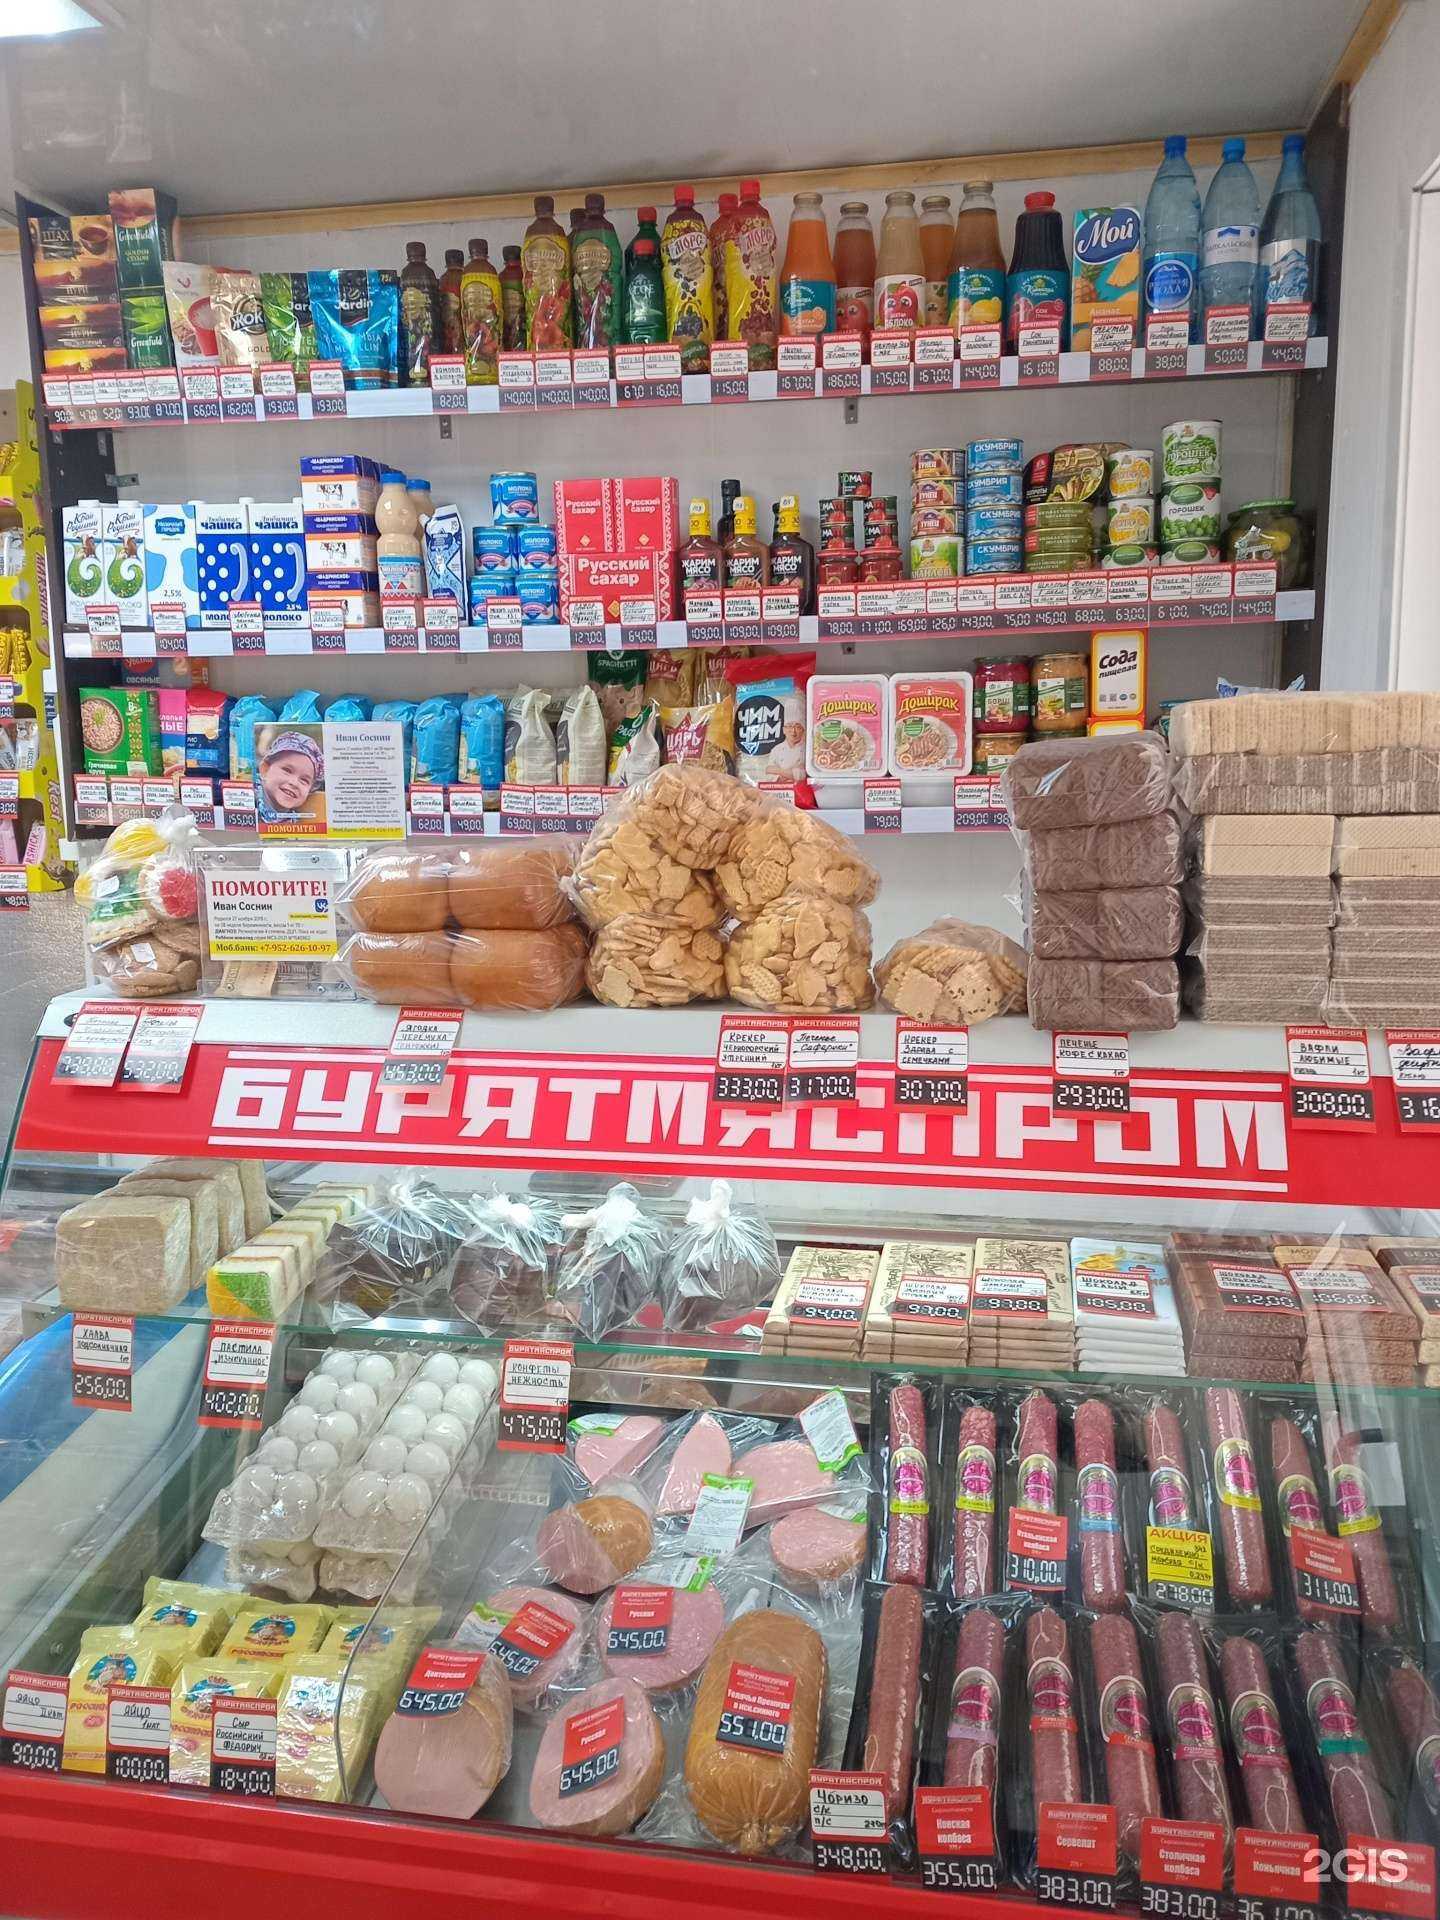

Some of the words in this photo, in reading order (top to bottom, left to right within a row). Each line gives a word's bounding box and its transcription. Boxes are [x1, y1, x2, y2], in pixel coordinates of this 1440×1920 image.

[1078, 218, 1133, 253] Мой
[334, 300, 373, 311] Jardin
[974, 442, 1018, 453] СКУМБРИЯ
[967, 478, 1007, 489] СКУМБРИЯ
[566, 499, 601, 509] Русский
[625, 498, 660, 508] Русский
[571, 506, 597, 515] сахар
[630, 506, 656, 514] сахар
[1168, 505, 1205, 515] ГОРОШЕК
[578, 556, 650, 573] Русский
[589, 572, 640, 587] сахар
[598, 659, 637, 667] SPAGHETTI
[1098, 649, 1137, 669] Сода
[1098, 664, 1138, 679] пищевая
[816, 699, 878, 721] Доширак
[898, 694, 959, 714] Доширак
[738, 704, 781, 726] ЧИМ
[739, 722, 781, 743] ЧИМ
[666, 734, 701, 750] ЦАРЬ
[211, 880, 328, 897] ПОМОГИТЕ!
[213, 902, 237, 911] Иван
[238, 902, 273, 911] Соснин
[729, 1033, 766, 1042] КРЕКЕР
[904, 1035, 937, 1044] КРЕКЕР
[1300, 1043, 1340, 1053] ВАФЛИ
[902, 1056, 950, 1065] СЕМЕЧКАМИ
[1299, 1055, 1350, 1065] ЛЮБИМЫЕ
[214, 1066, 1290, 1171] БУРЯТМЯСПРОМ
[83, 1328, 110, 1340] ХАЛВА
[220, 1342, 262, 1353] ПАСТИЛА
[512, 1362, 560, 1375] КОНФЕТЫ
[1150, 1528, 1208, 1544] АКЦИЯ
[424, 1669, 466, 1680] Докторская
[16, 1693, 41, 1706] ЯЙЦО
[123, 1704, 151, 1717] ЯЙЦО
[232, 1717, 250, 1729] Сыр
[216, 1729, 264, 1741] Российский
[936, 1818, 970, 1830] Конская
[937, 1832, 972, 1845] колбаса
[1056, 1835, 1096, 1849] Сервелат
[1159, 1849, 1206, 1864] Столичная
[1164, 1864, 1201, 1877] колбаса
[1253, 1860, 1301, 1876] Коньячная
